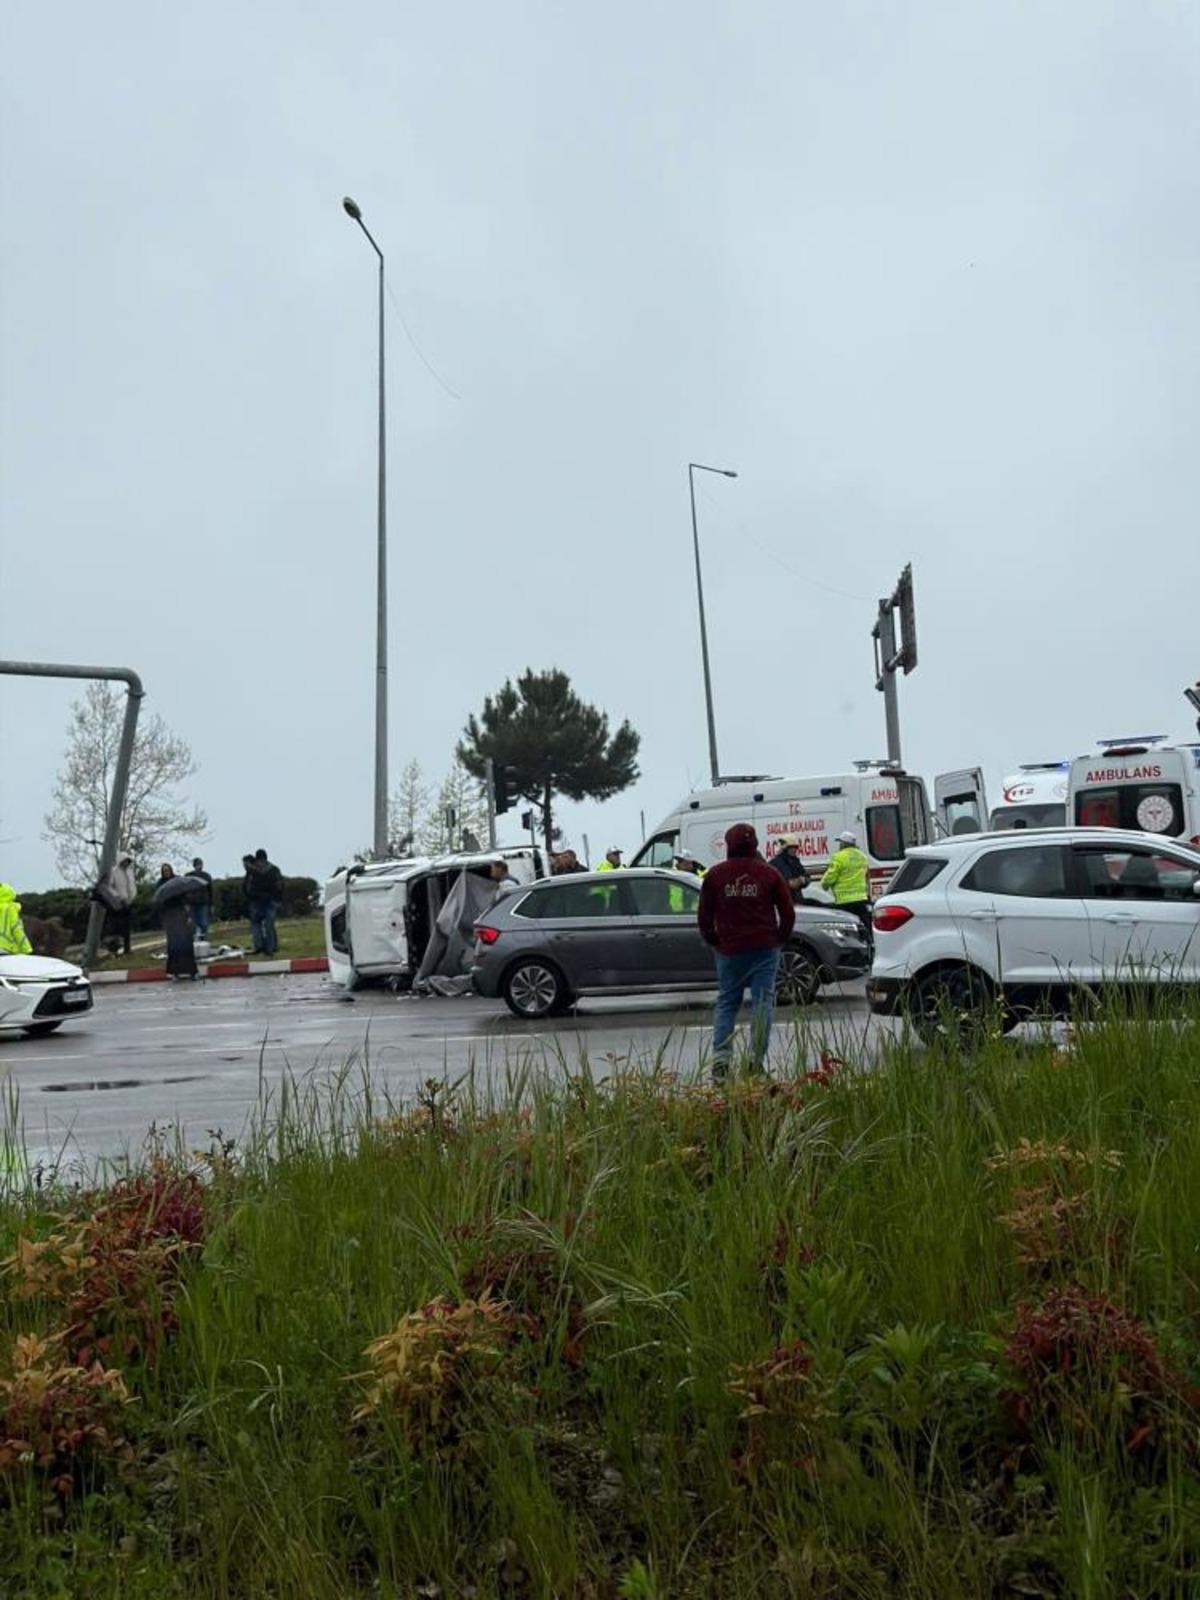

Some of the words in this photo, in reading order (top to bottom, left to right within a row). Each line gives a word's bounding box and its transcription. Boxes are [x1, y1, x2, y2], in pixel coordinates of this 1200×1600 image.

[1086, 766, 1161, 783] AMBULANS
[1011, 787, 1034, 797] 112
[767, 821, 788, 834] SAĞLIK
[796, 835, 829, 857] AĞLIK
